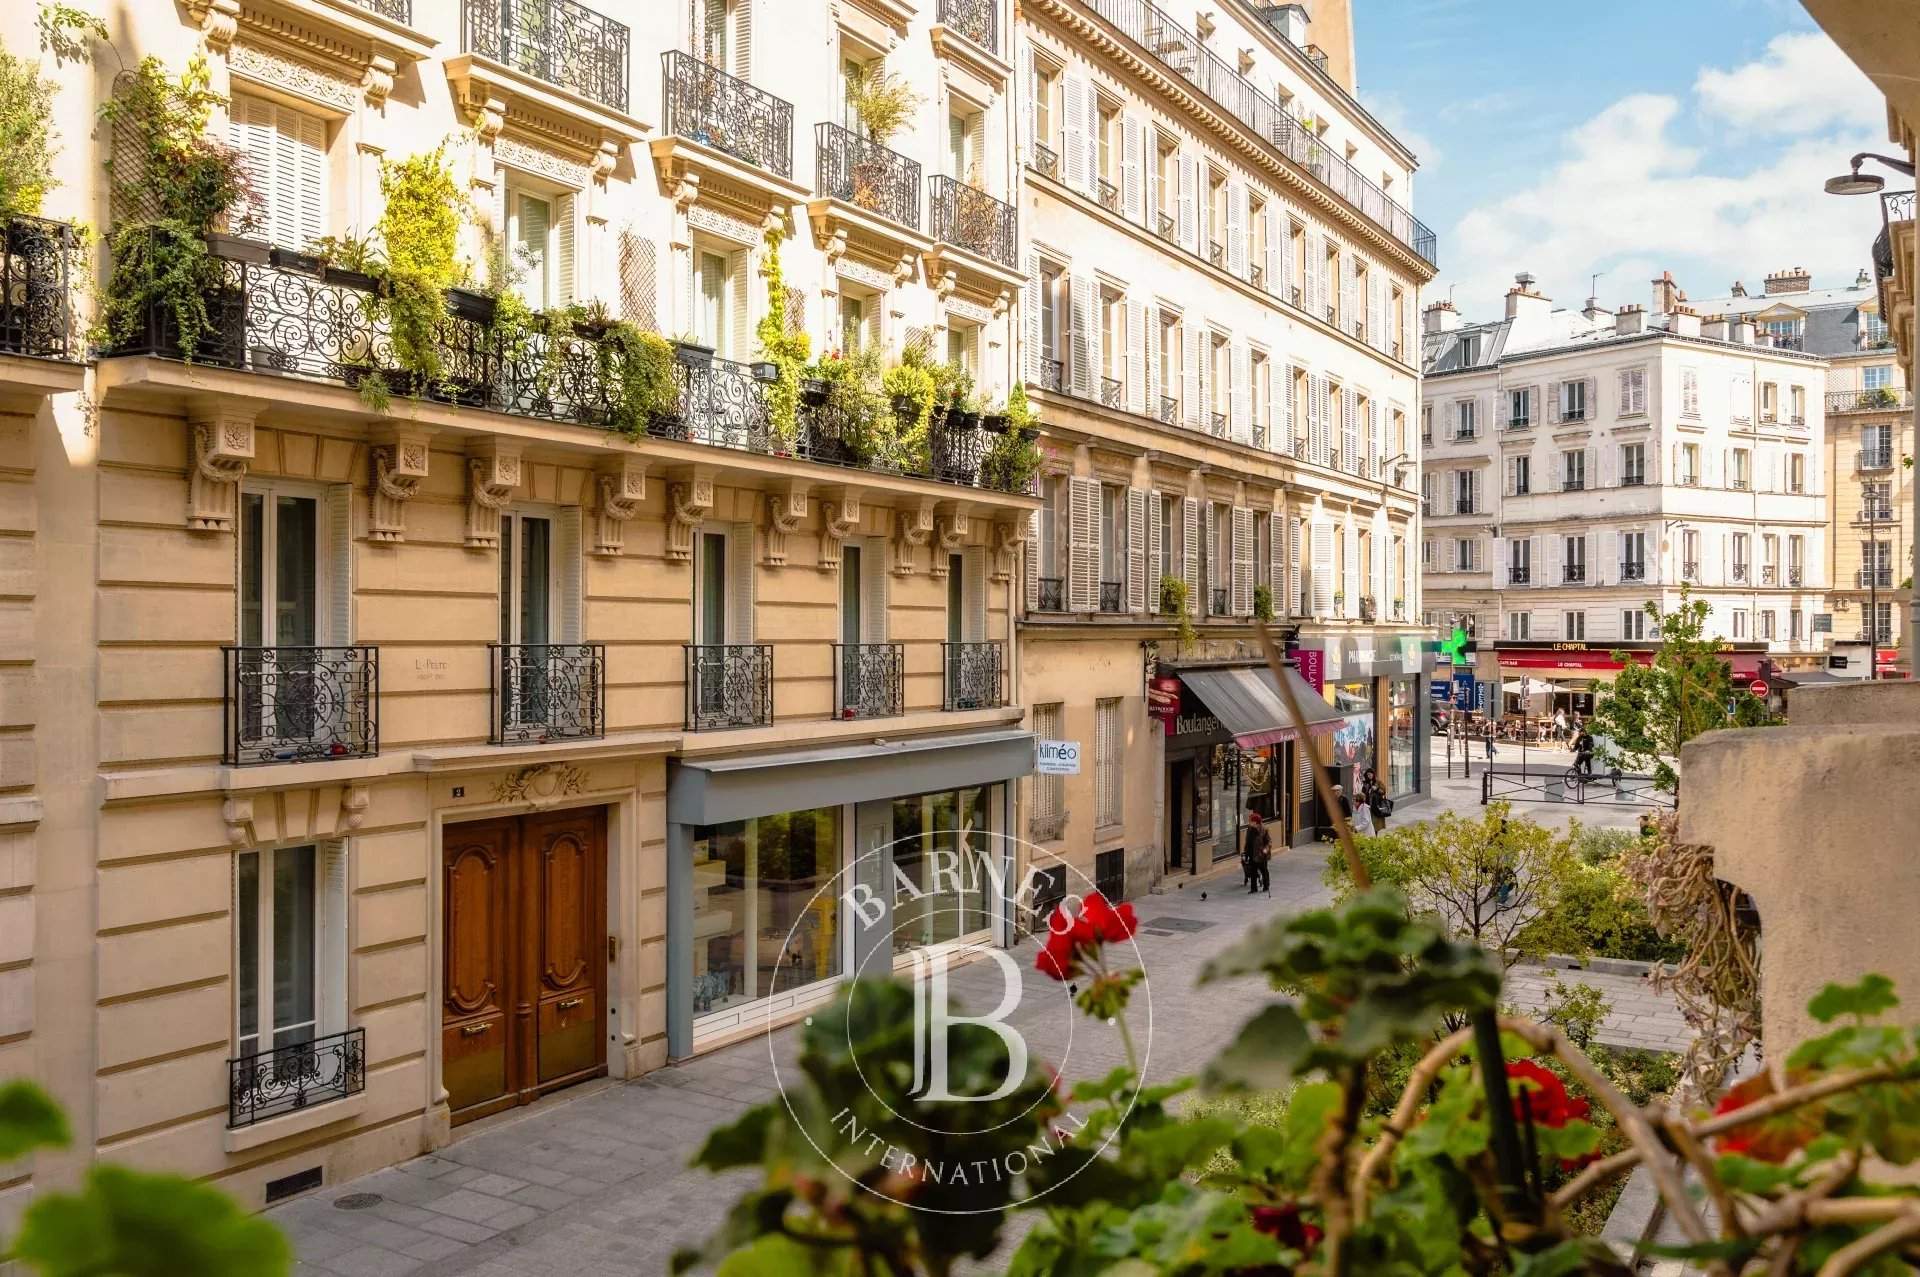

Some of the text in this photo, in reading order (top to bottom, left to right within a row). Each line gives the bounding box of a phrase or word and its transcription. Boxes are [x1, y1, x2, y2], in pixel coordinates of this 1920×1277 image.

[1553, 643, 1588, 651] LE CHAPTAL
[1308, 651, 1317, 690] BOULAN
[1039, 743, 1077, 760] kliméo
